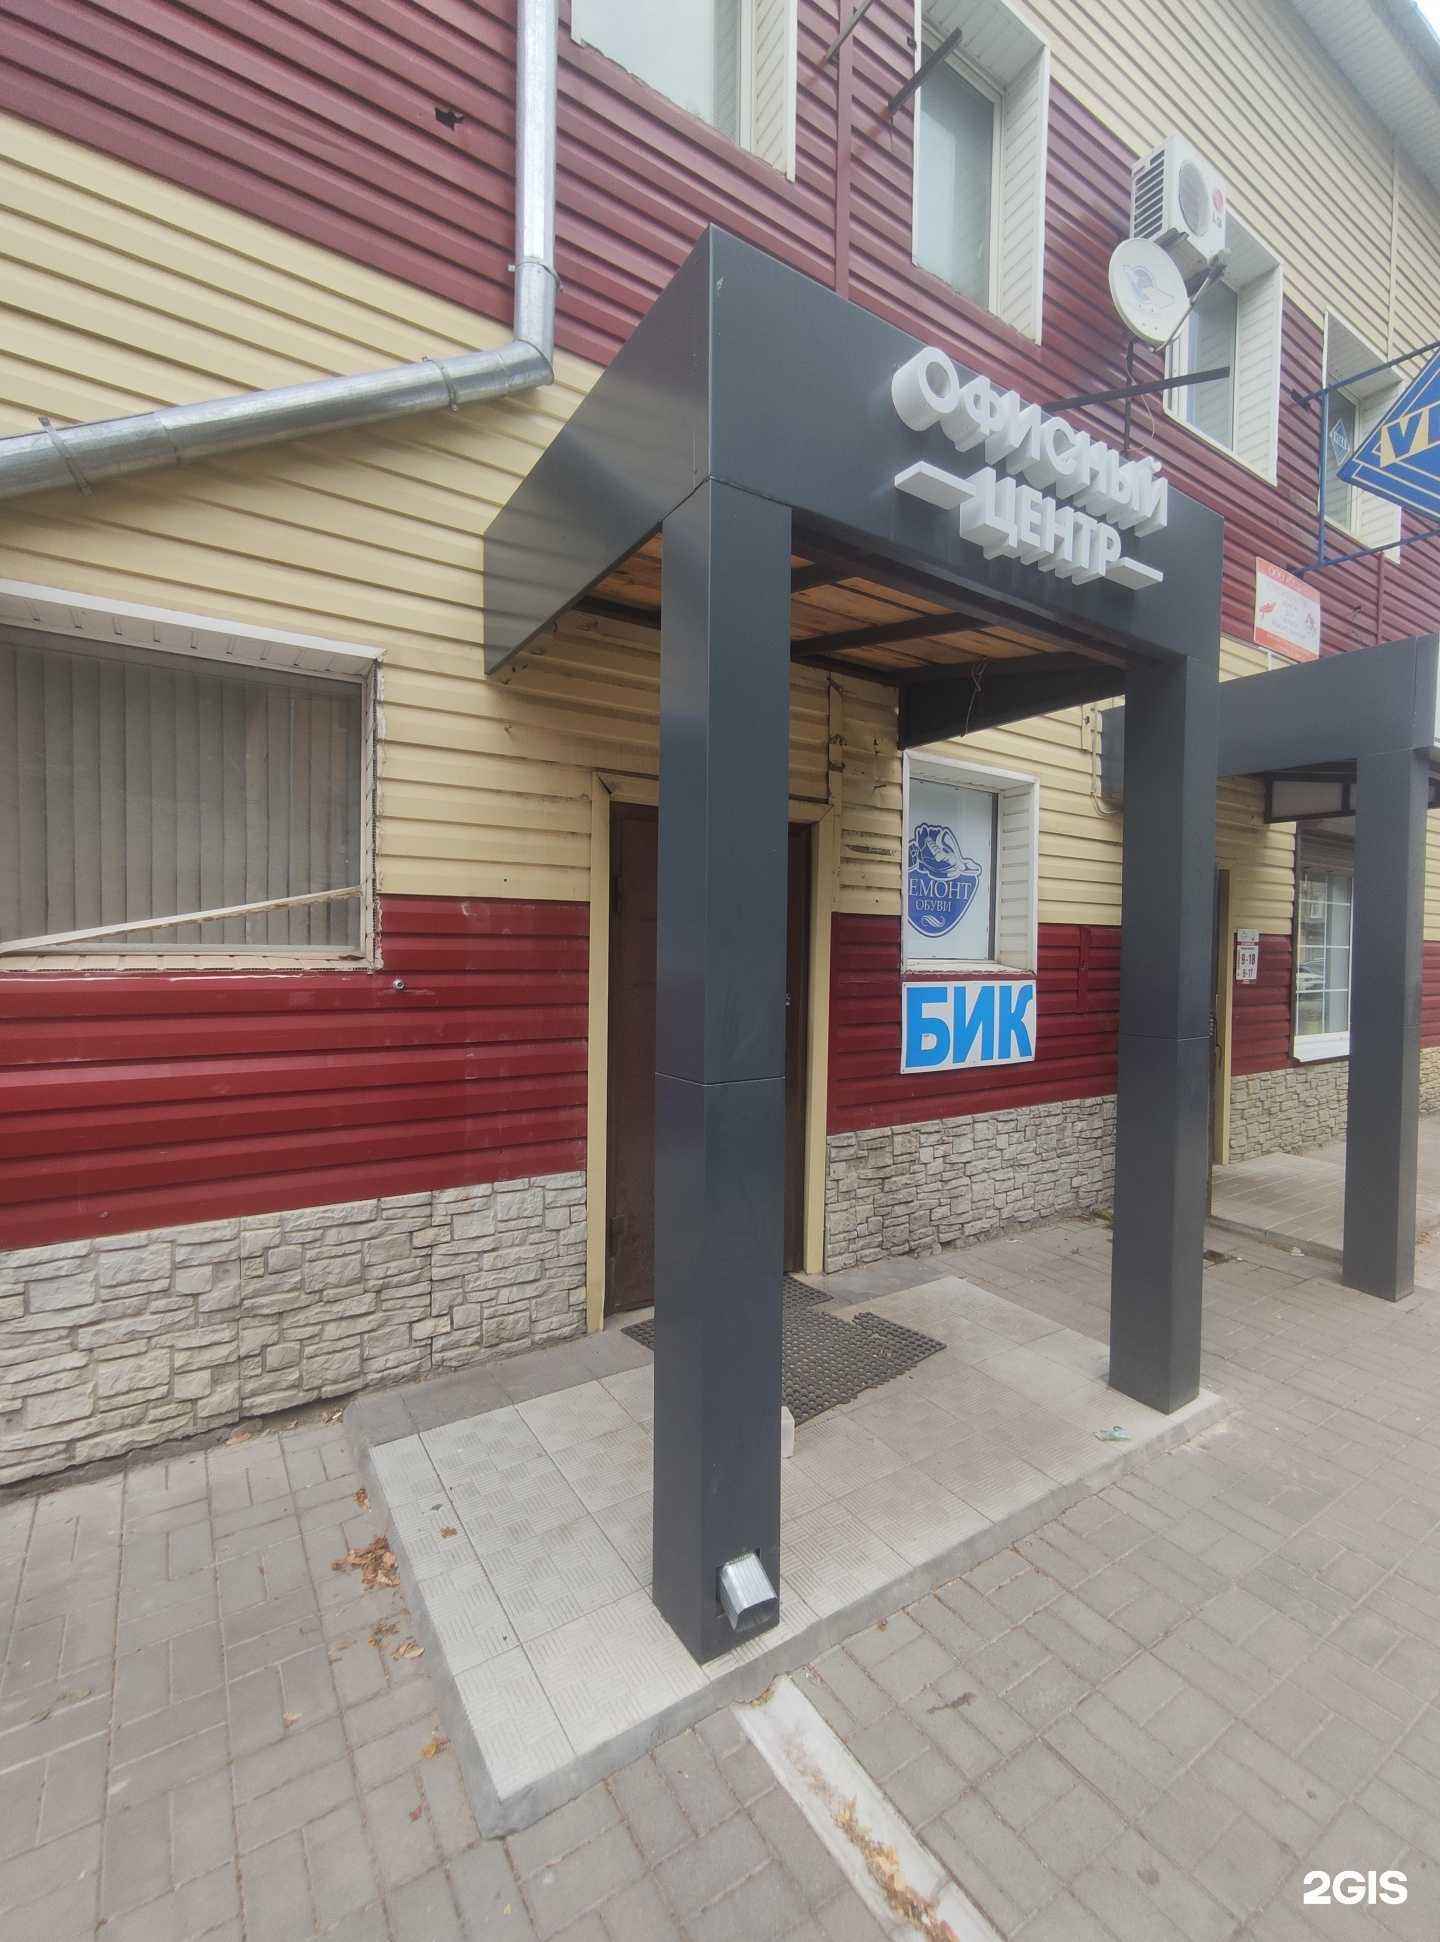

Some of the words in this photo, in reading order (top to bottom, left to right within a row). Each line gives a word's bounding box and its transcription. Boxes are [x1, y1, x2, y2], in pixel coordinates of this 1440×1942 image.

[892, 346, 1168, 538] ОФИСНЫЙ
[959, 466, 1122, 586] ЦЕНТР
[908, 878, 972, 900] ЕМОНТ
[915, 899, 953, 912] ОБУВИ
[904, 984, 1033, 1069] БИК
